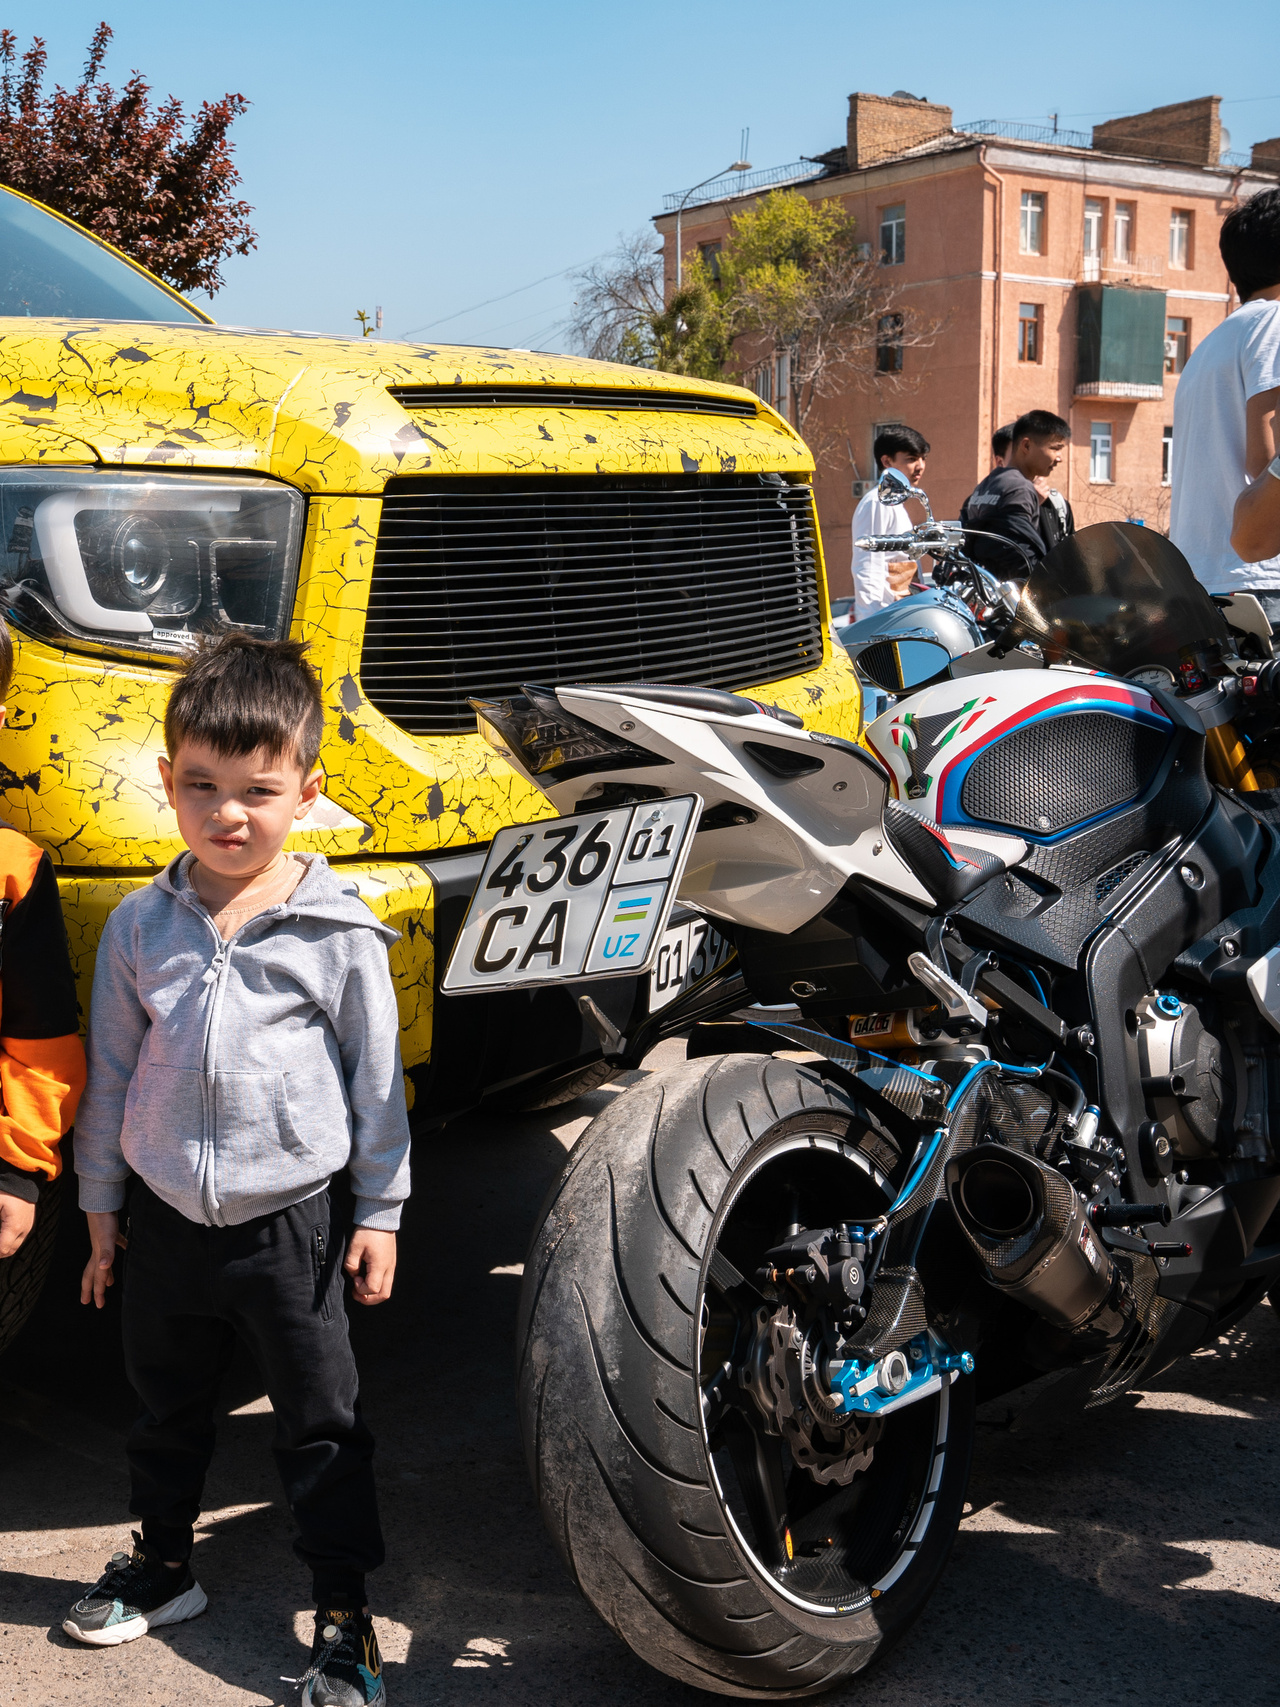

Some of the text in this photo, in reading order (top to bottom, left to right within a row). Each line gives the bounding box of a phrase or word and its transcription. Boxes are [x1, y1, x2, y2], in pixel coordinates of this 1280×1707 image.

[156, 630, 190, 640] approved
[485, 818, 673, 898] 436 01
[472, 899, 570, 974] CA
[602, 932, 641, 960] UZ
[656, 939, 684, 993] 01
